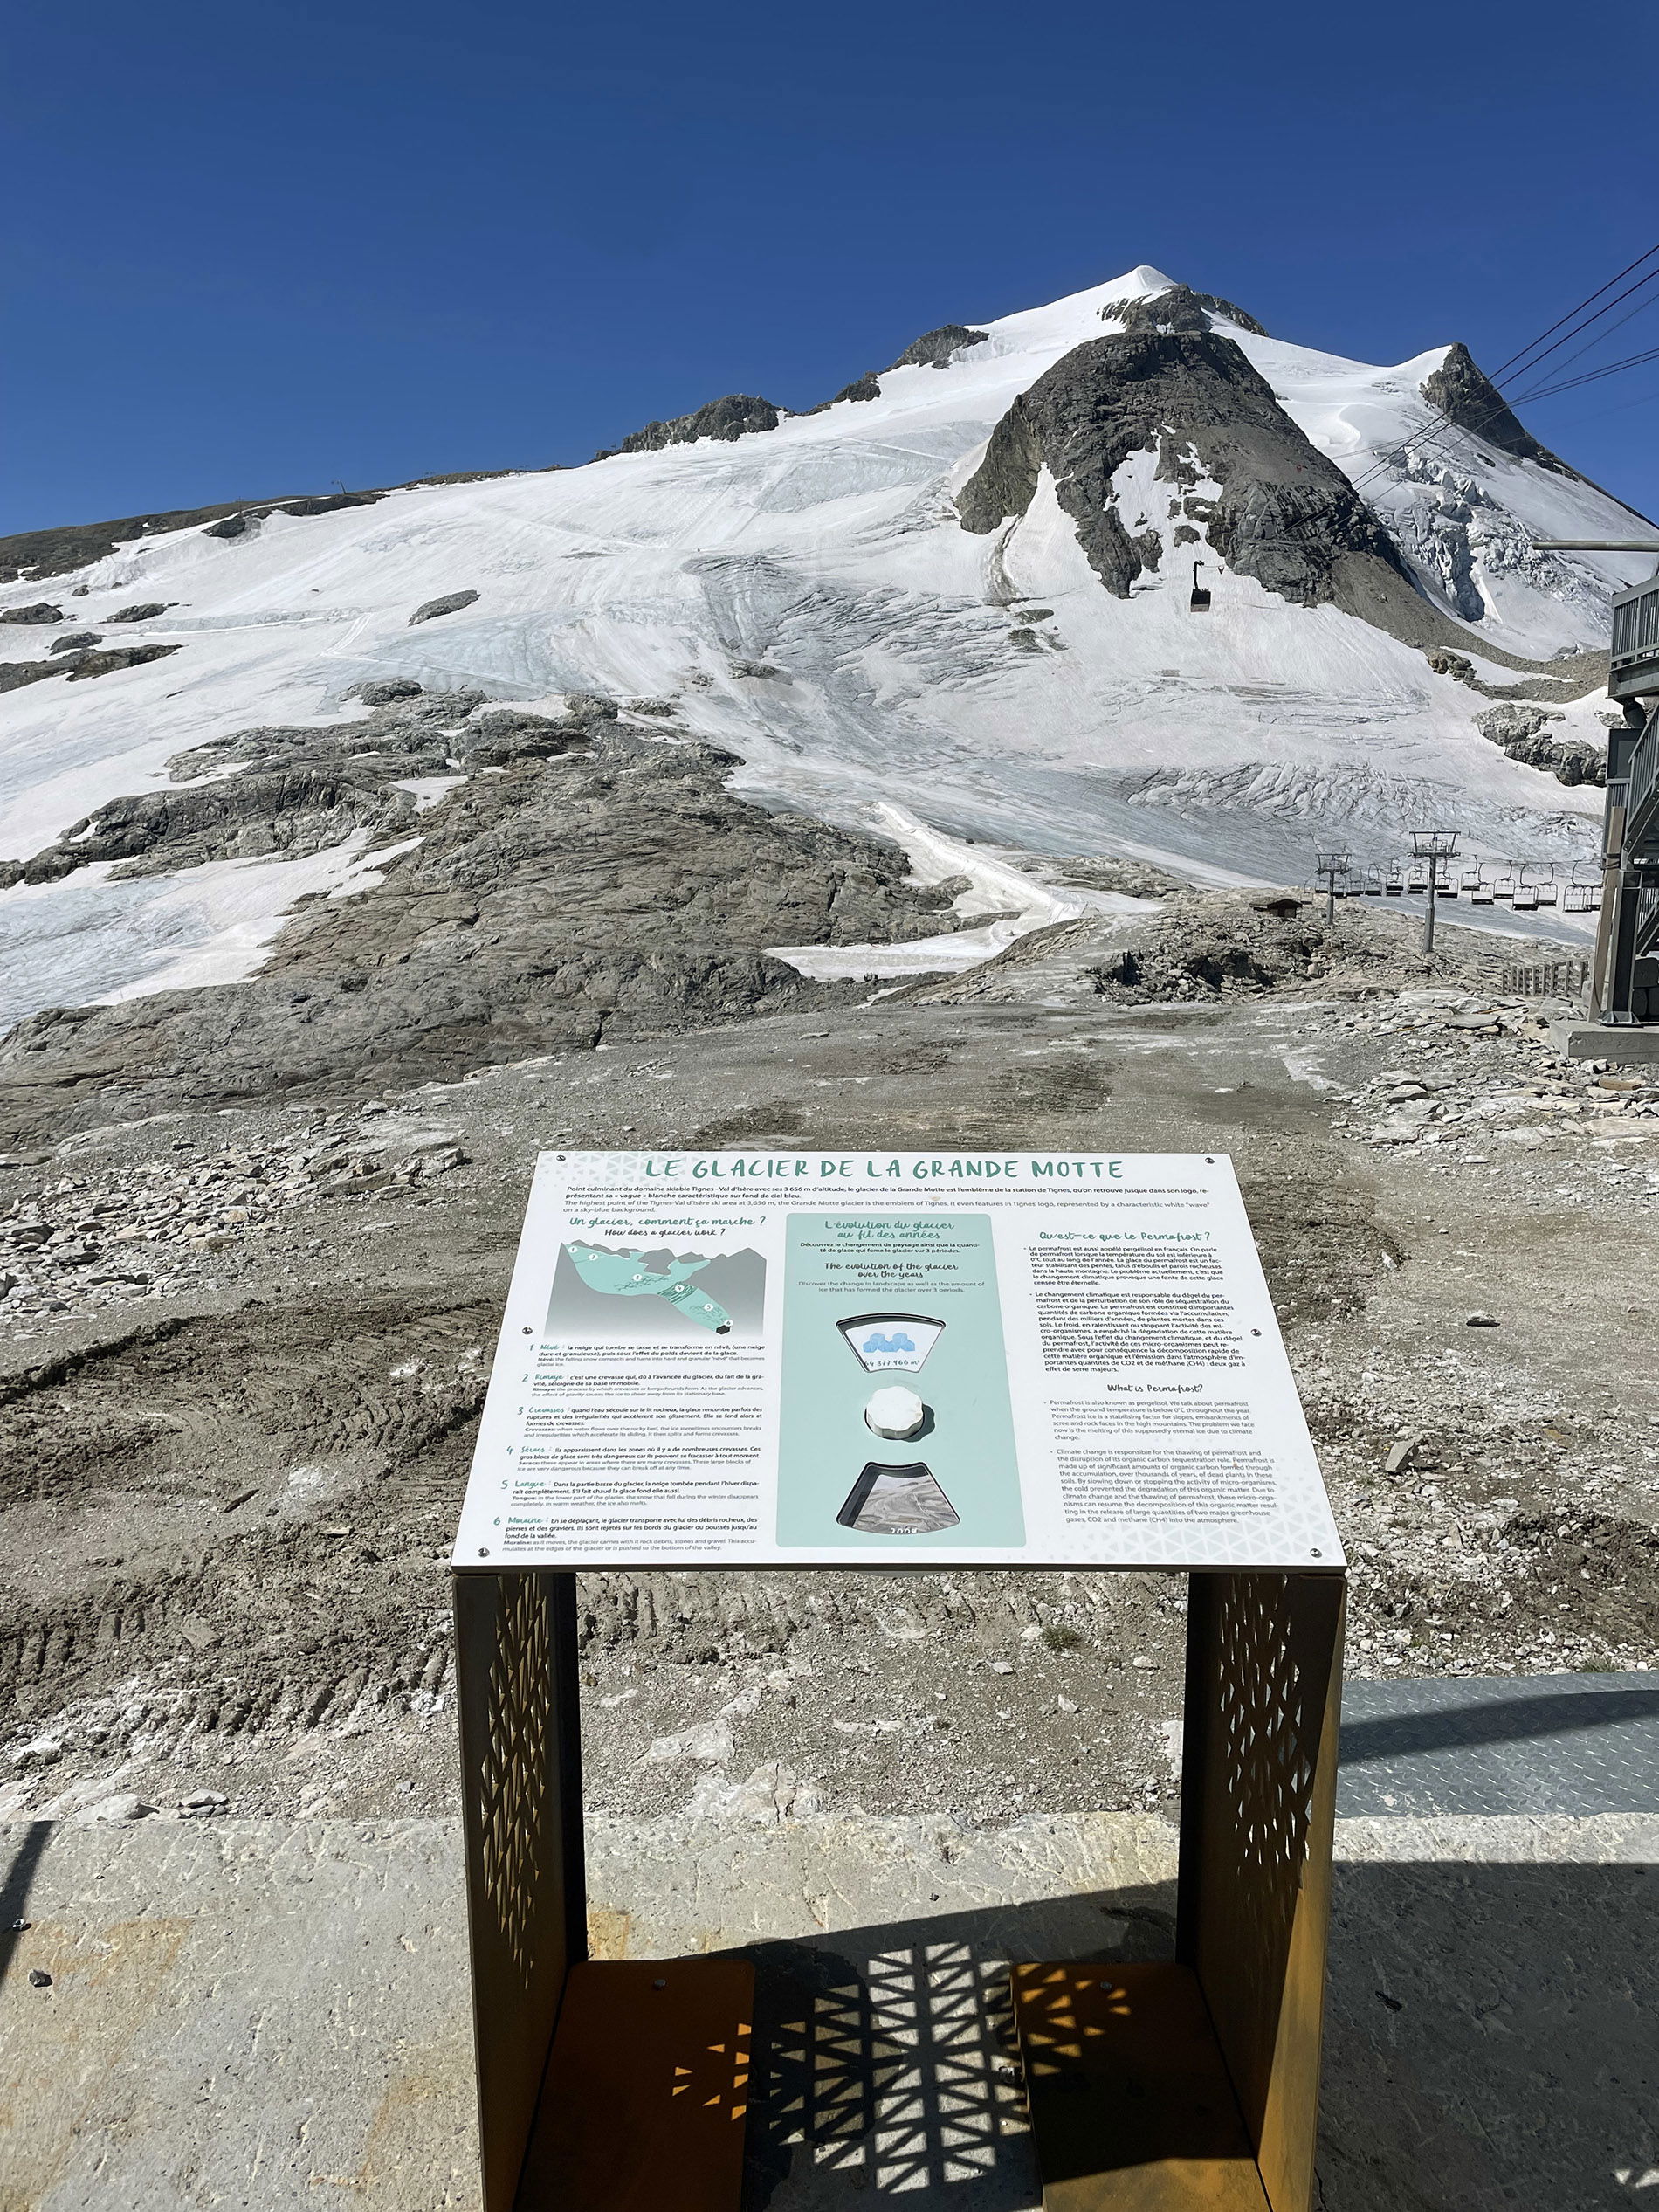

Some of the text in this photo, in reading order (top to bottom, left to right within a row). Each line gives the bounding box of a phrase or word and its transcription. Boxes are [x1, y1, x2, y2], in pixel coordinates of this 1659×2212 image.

[645, 1158, 1123, 1179] LE GLACIER DE LA GRANDE MOTTE
[587, 1216, 632, 1228] glacier,
[637, 1216, 694, 1225] comment
[693, 1218, 709, 1228] ça
[712, 1216, 755, 1225] marche
[824, 1220, 954, 1231] L'évolution du glacier
[657, 1229, 692, 1237] glacier
[857, 1230, 874, 1239] fil
[876, 1230, 895, 1238] des
[898, 1230, 940, 1239] années
[1140, 1231, 1201, 1242] Permafrost
[844, 1262, 891, 1271] evolution
[892, 1262, 903, 1271] of
[924, 1263, 958, 1271] glacier
[898, 1270, 923, 1279] years
[522, 1374, 528, 1382] 2
[1106, 1383, 1133, 1392] What
[1146, 1383, 1202, 1394] Permafrost?
[517, 1406, 524, 1415] 3
[506, 1445, 513, 1455] 4
[500, 1479, 547, 1489] 5 Langue
[493, 1516, 501, 1526] 6
